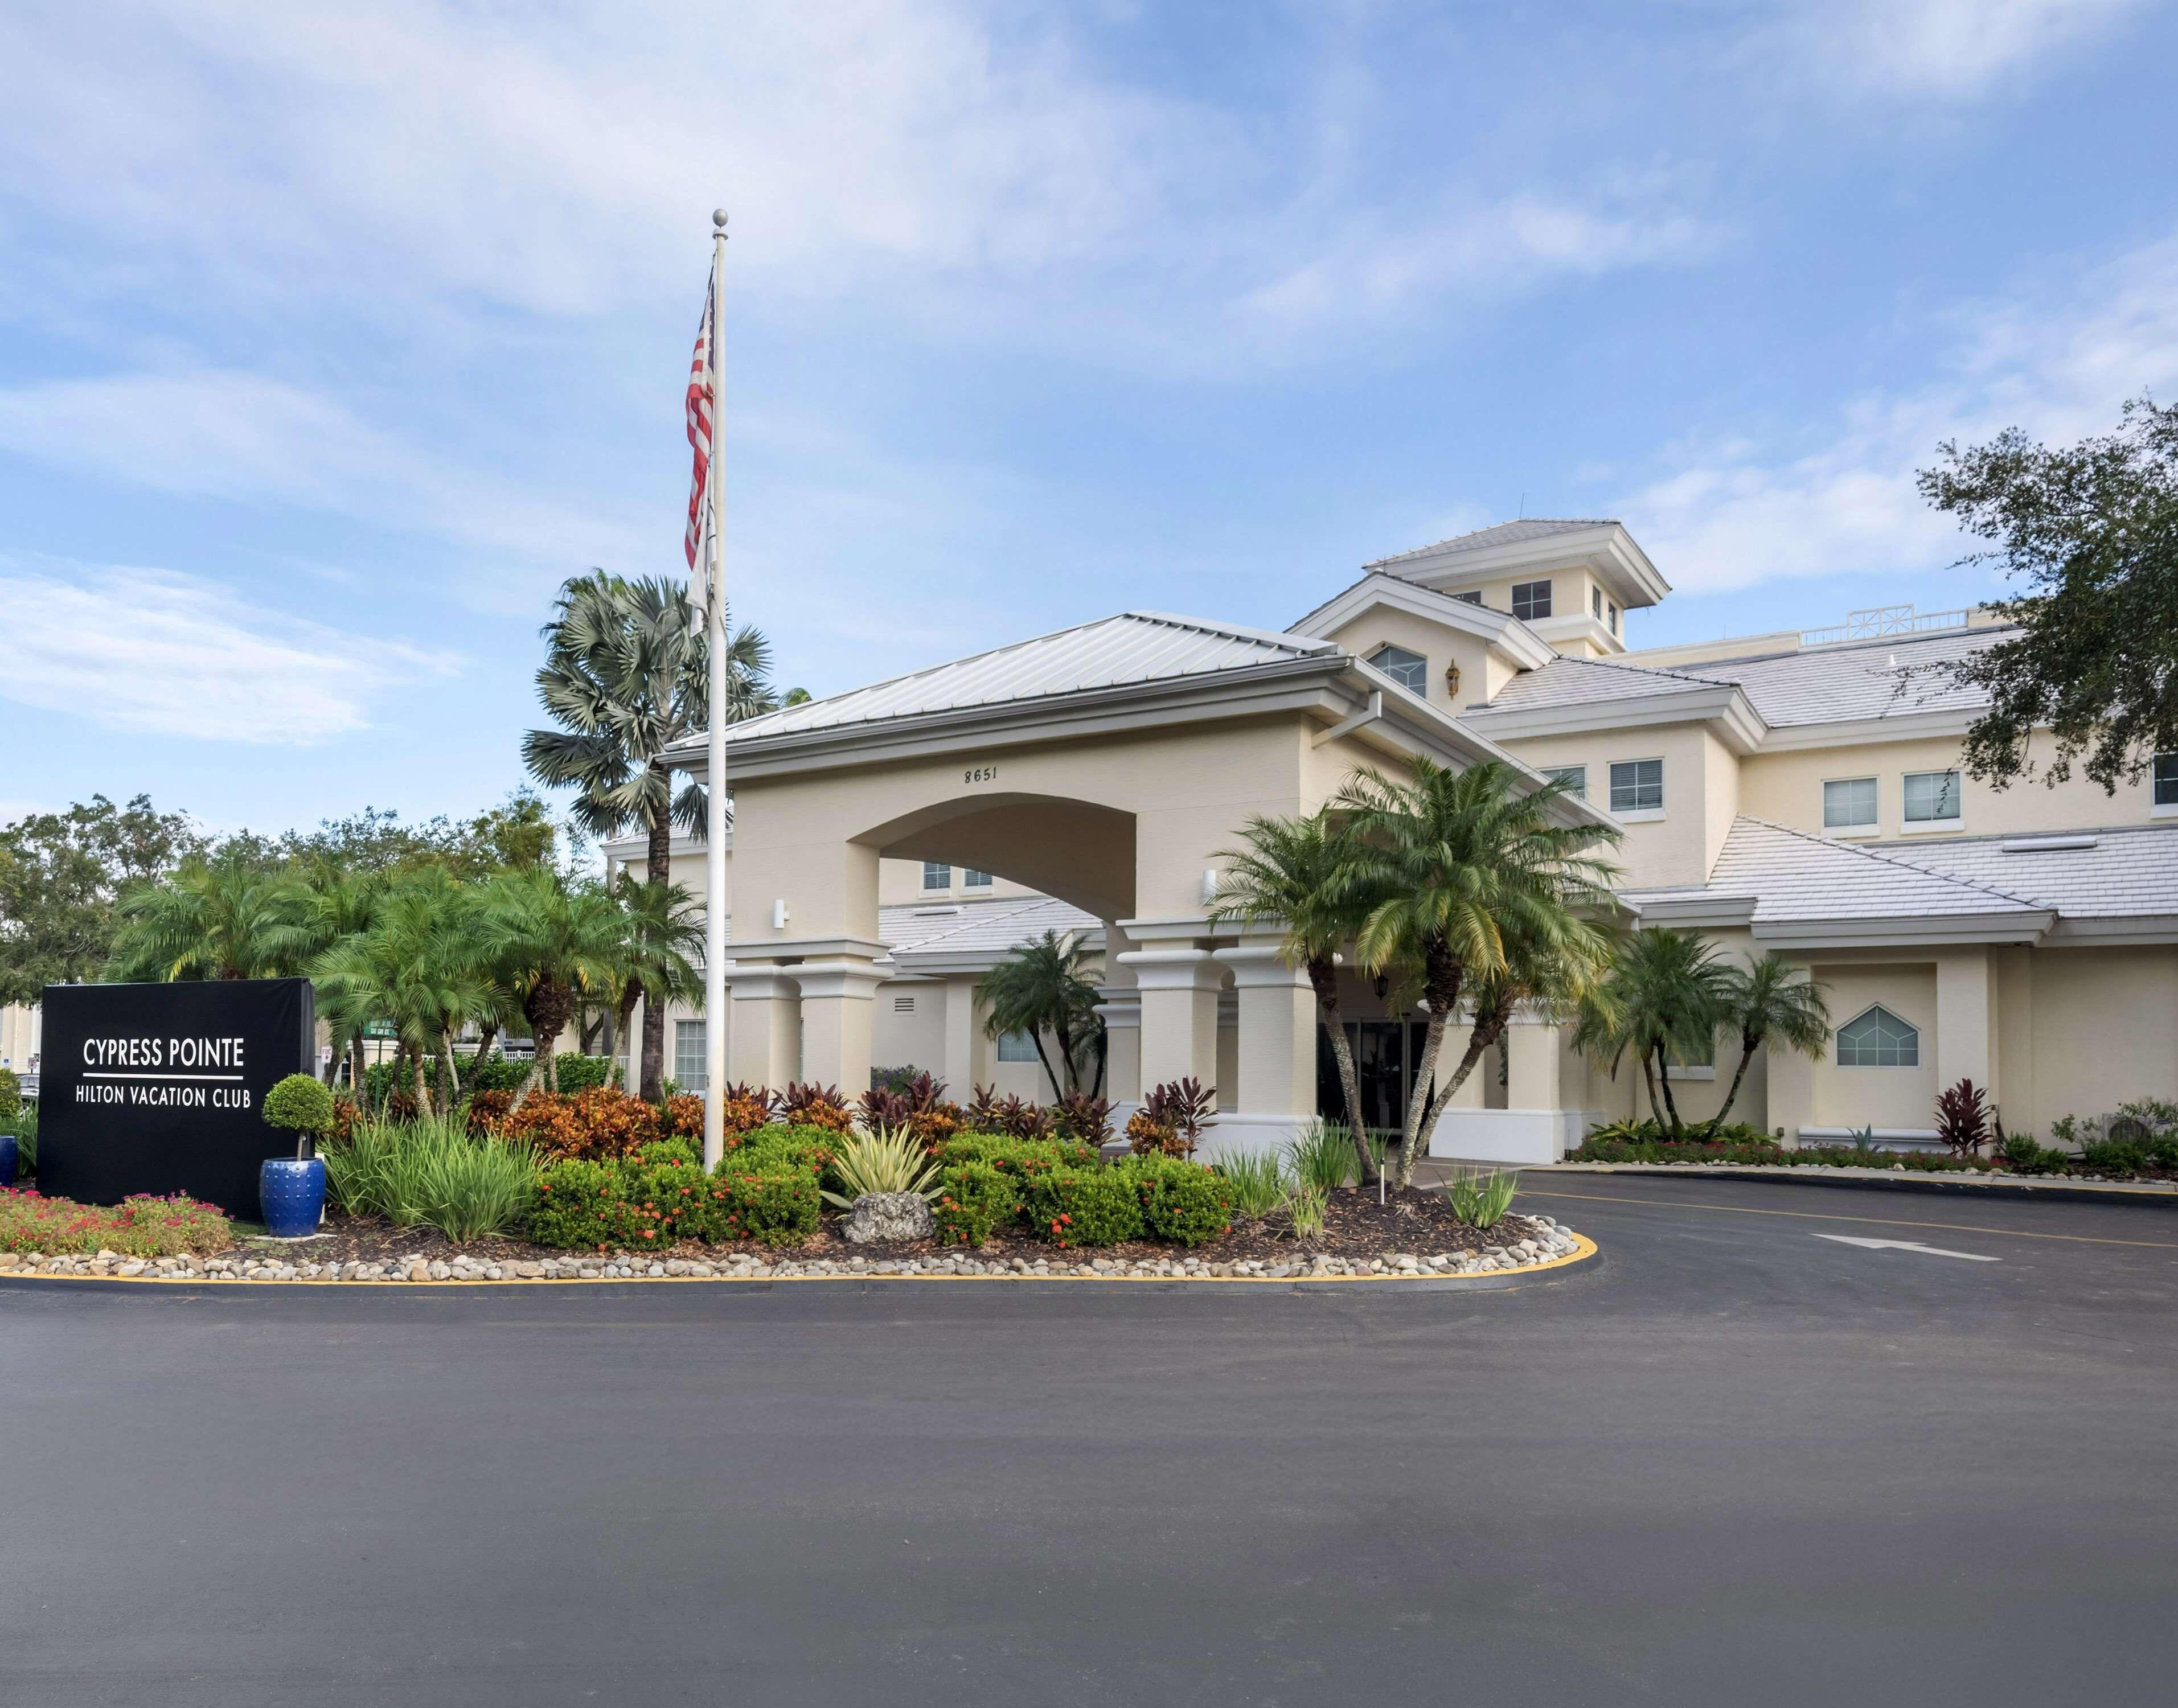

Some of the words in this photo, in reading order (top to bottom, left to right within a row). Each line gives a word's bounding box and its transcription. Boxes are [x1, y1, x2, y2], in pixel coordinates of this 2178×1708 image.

[965, 766, 997, 784] 8651
[83, 1038, 162, 1066] CYPRESS
[169, 1037, 244, 1068] POINTE
[76, 1085, 124, 1104] HILTON
[130, 1086, 206, 1107] VACATION
[212, 1088, 251, 1108] CLUB
